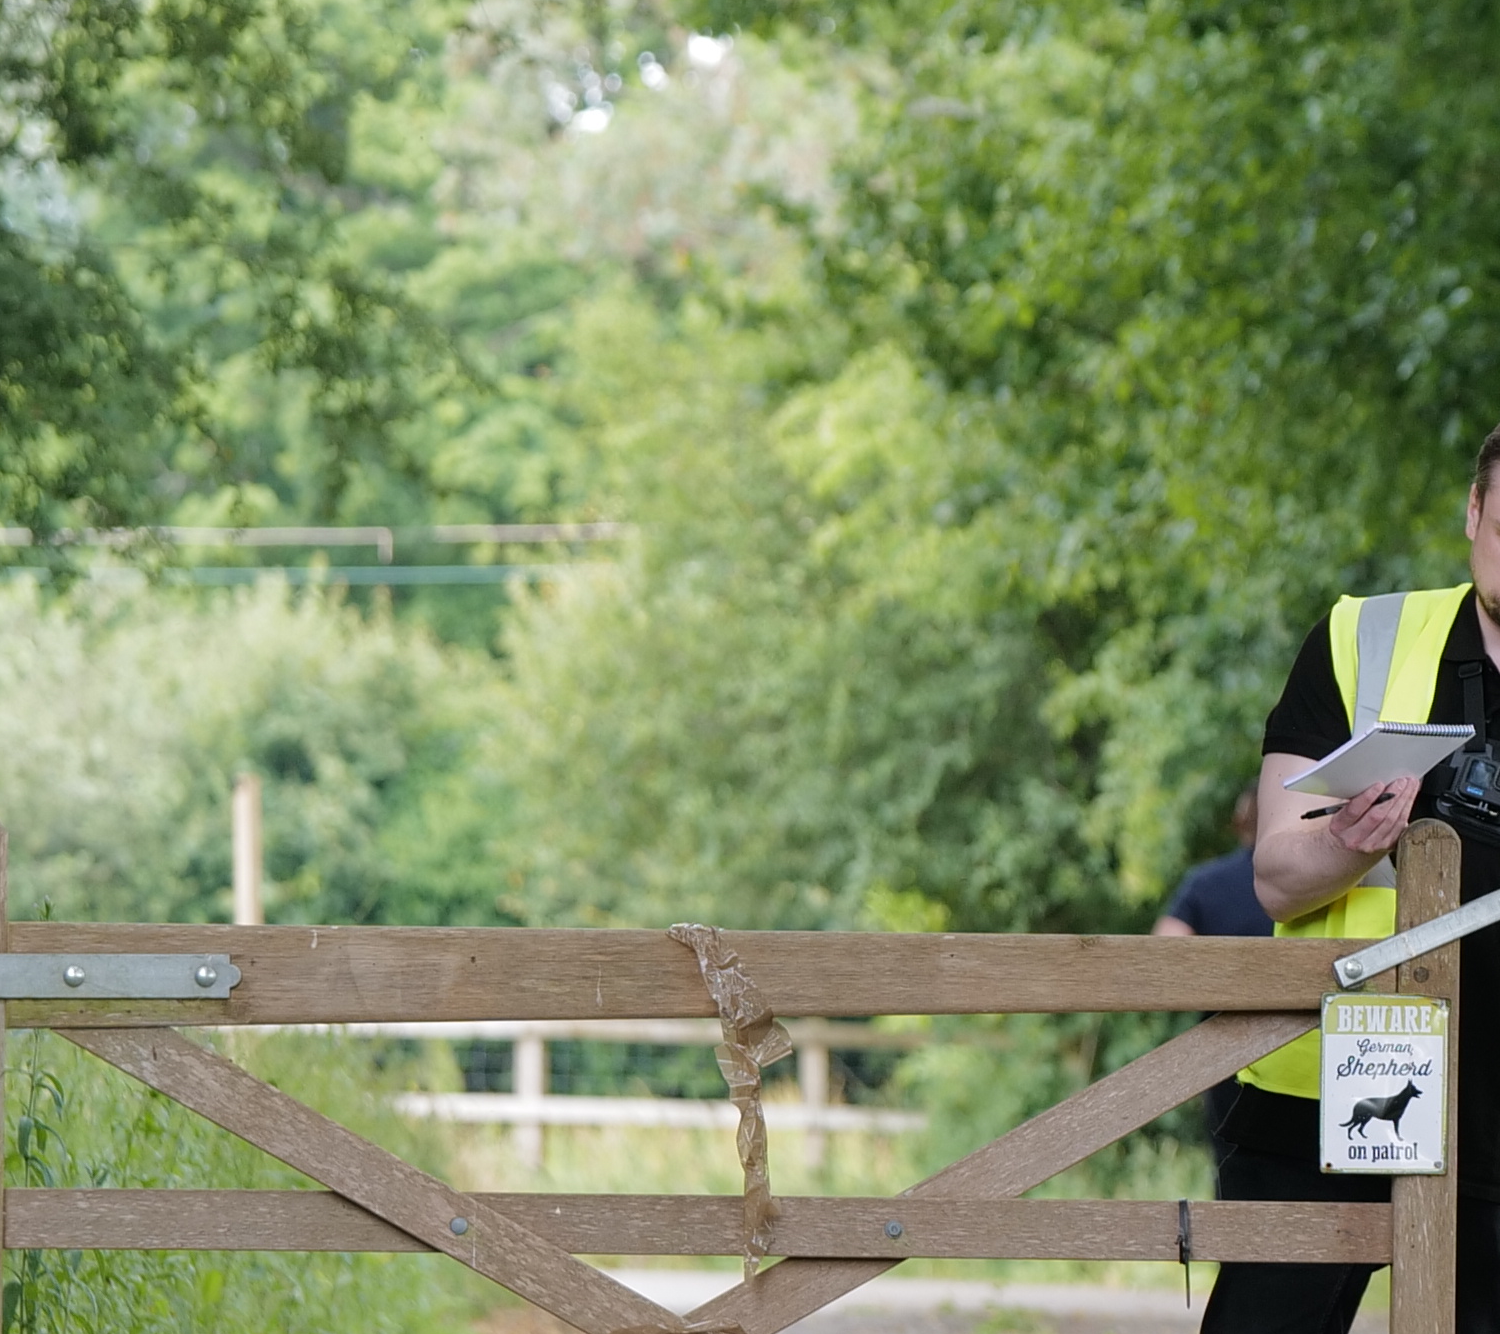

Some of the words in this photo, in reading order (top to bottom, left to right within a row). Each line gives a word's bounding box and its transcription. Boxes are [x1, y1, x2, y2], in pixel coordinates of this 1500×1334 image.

[1336, 1005, 1432, 1034] BEWARE
[1356, 1038, 1414, 1056] German
[1336, 1055, 1433, 1080] Shepherd
[1348, 1144, 1367, 1160] on
[1372, 1142, 1418, 1162] patrol
